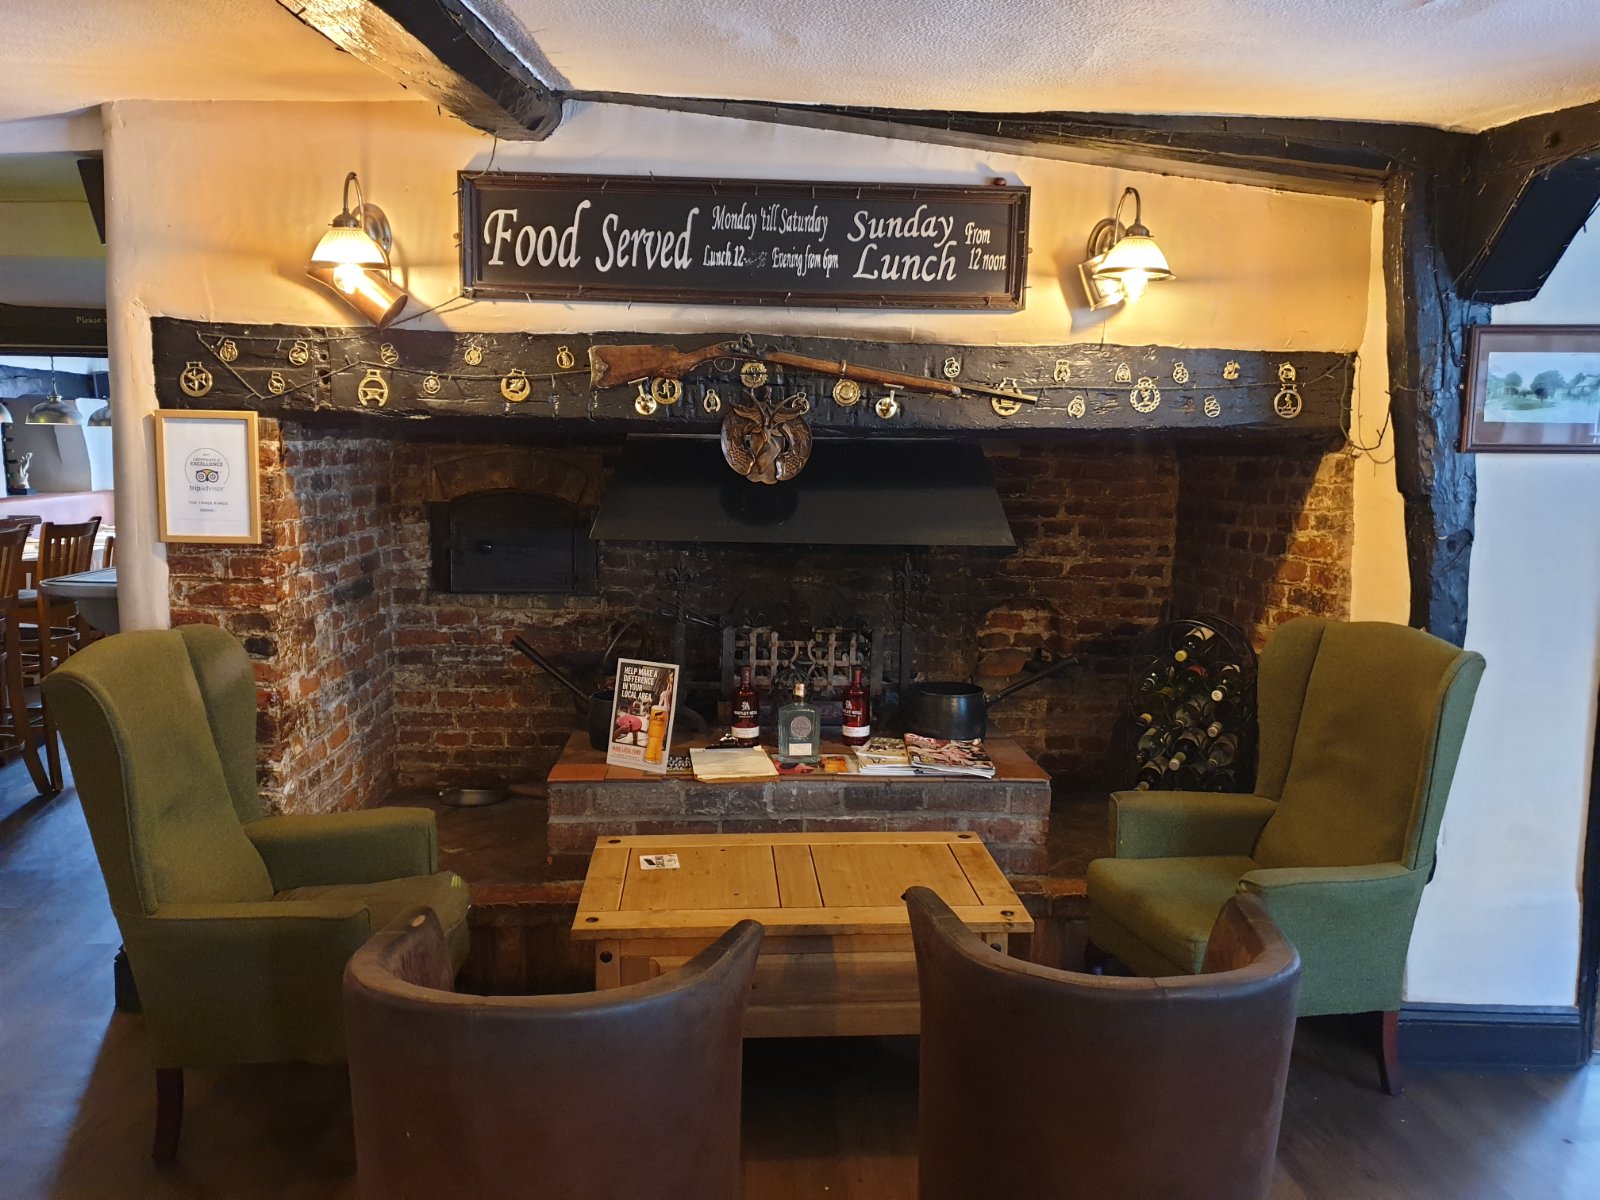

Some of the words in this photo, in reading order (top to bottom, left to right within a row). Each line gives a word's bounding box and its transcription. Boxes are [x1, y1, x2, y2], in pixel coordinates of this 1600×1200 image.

[711, 202, 757, 240] Monday
[779, 205, 828, 242] Saturday
[847, 204, 954, 249] Sunday
[964, 222, 991, 245] From
[483, 199, 591, 269] Food
[595, 207, 699, 272] Served
[703, 241, 732, 267] Lunch
[771, 247, 803, 277] Evening
[802, 244, 821, 277] from
[822, 248, 839, 278] 6pm
[853, 240, 957, 282] Lunch
[968, 247, 981, 270] 12
[982, 254, 1007, 271] noon
[75, 316, 101, 324] Please
[623, 675, 655, 686] DIFFERENCE
[624, 666, 638, 674] HELP
[639, 667, 654, 677] MAKE
[653, 670, 658, 678] A
[621, 690, 637, 699] LOCAL
[629, 683, 643, 692] YOUR
